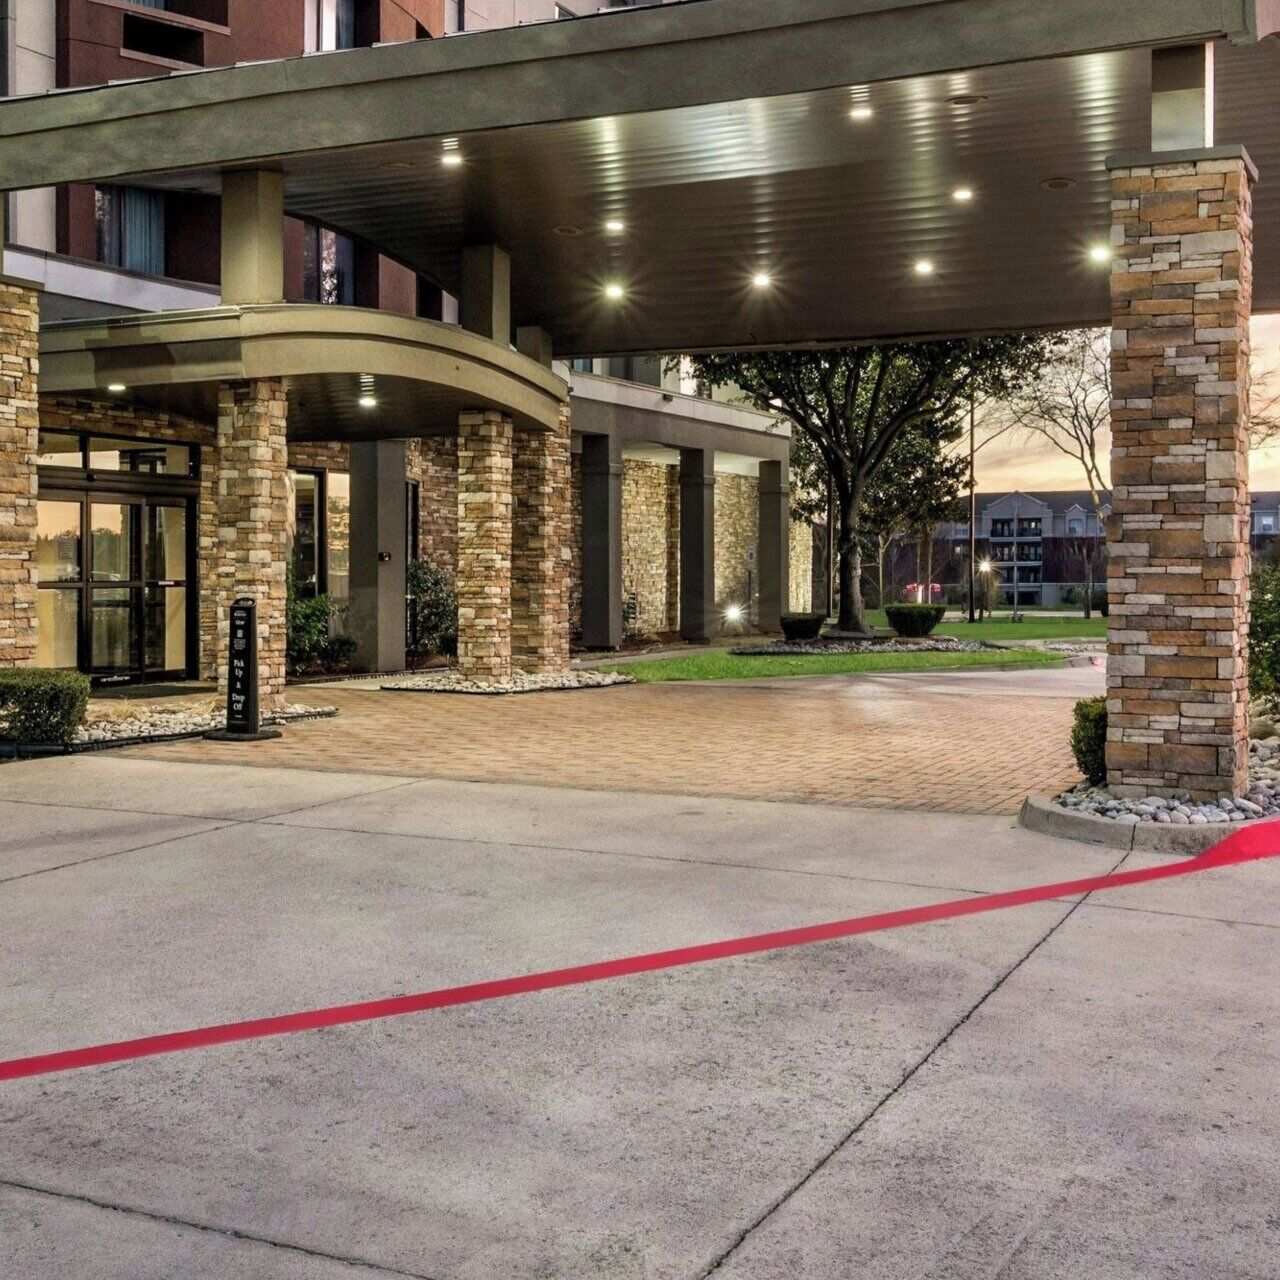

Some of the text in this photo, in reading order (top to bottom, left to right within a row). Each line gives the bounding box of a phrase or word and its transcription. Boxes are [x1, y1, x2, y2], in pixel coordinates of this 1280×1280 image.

[233, 659, 245, 667] Pick
[235, 668, 244, 678] Up
[232, 692, 246, 703] Drop
[233, 702, 243, 711] Off
